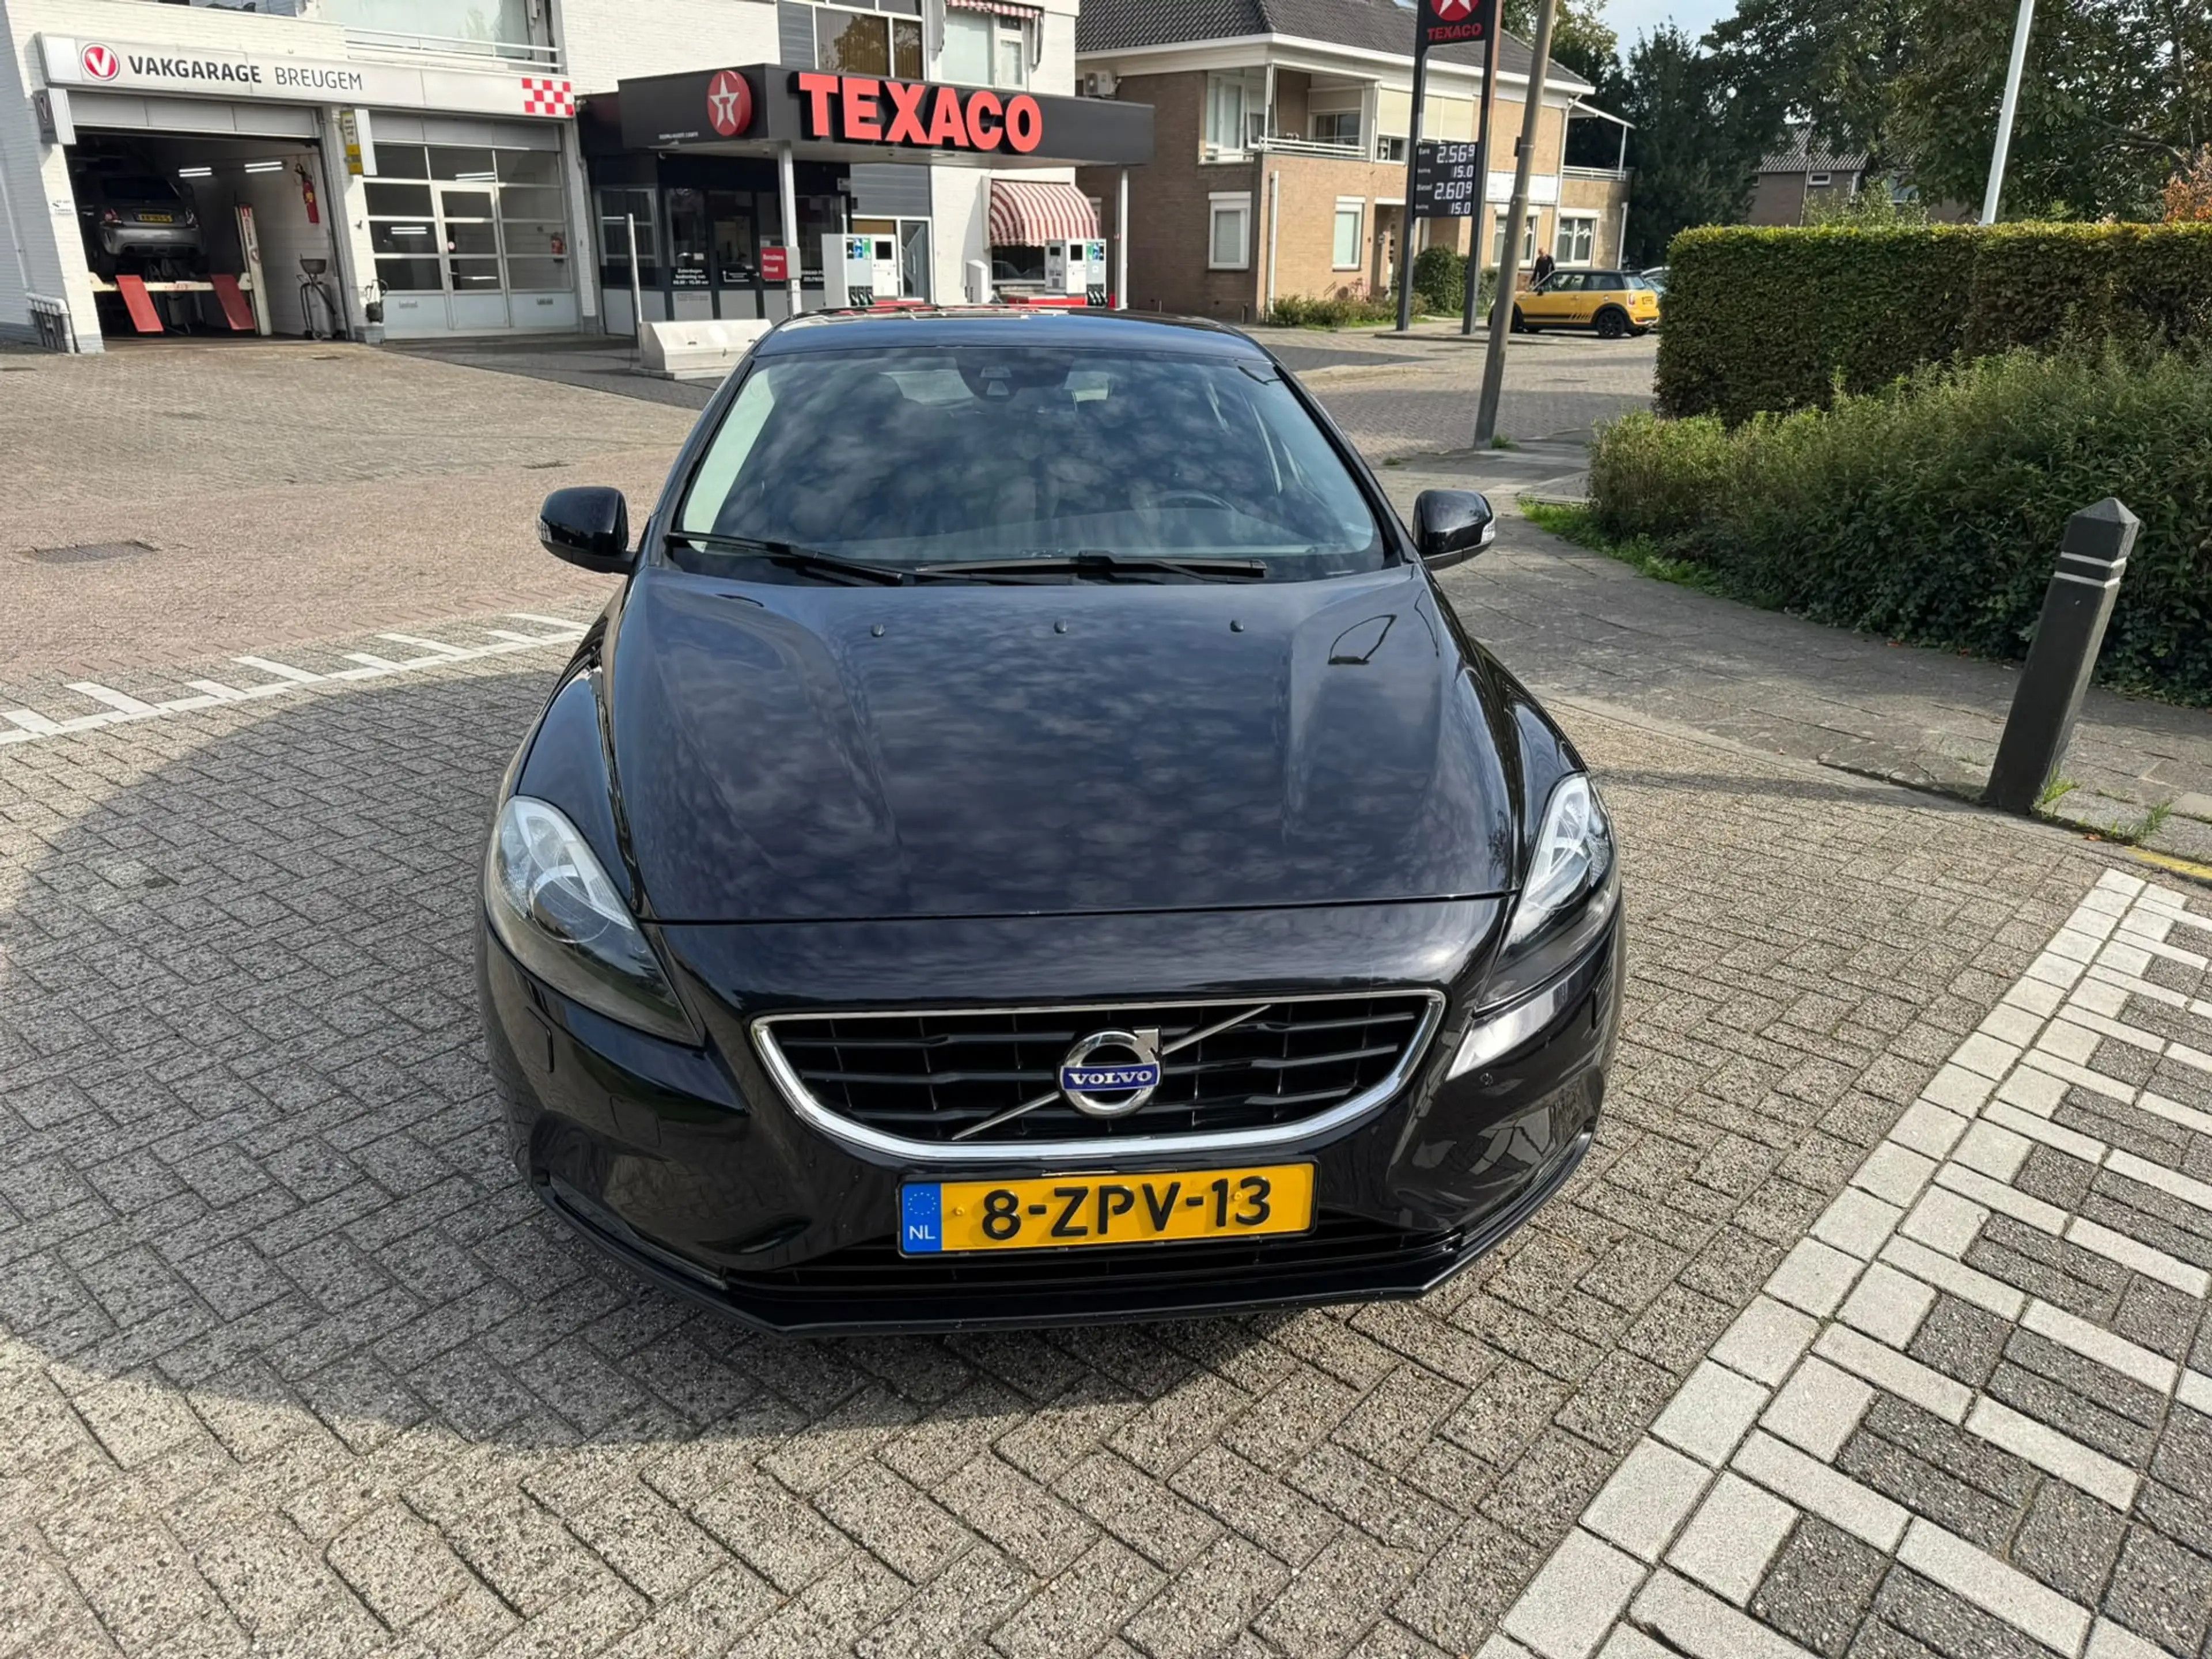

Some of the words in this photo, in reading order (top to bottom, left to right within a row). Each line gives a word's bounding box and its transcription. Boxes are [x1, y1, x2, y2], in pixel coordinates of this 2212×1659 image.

[1427, 23, 1483, 40] TEXACO
[128, 55, 262, 84] VAKGARAGE
[275, 66, 363, 90] BREUGEM
[798, 72, 1043, 153] TEXACO
[1453, 165, 1474, 178] 15.0
[1450, 202, 1471, 215] 15.0
[1069, 1070, 1153, 1085] VOLVO
[982, 1176, 1271, 1241] 8-ZPV-13
[908, 1225, 936, 1240] NL
